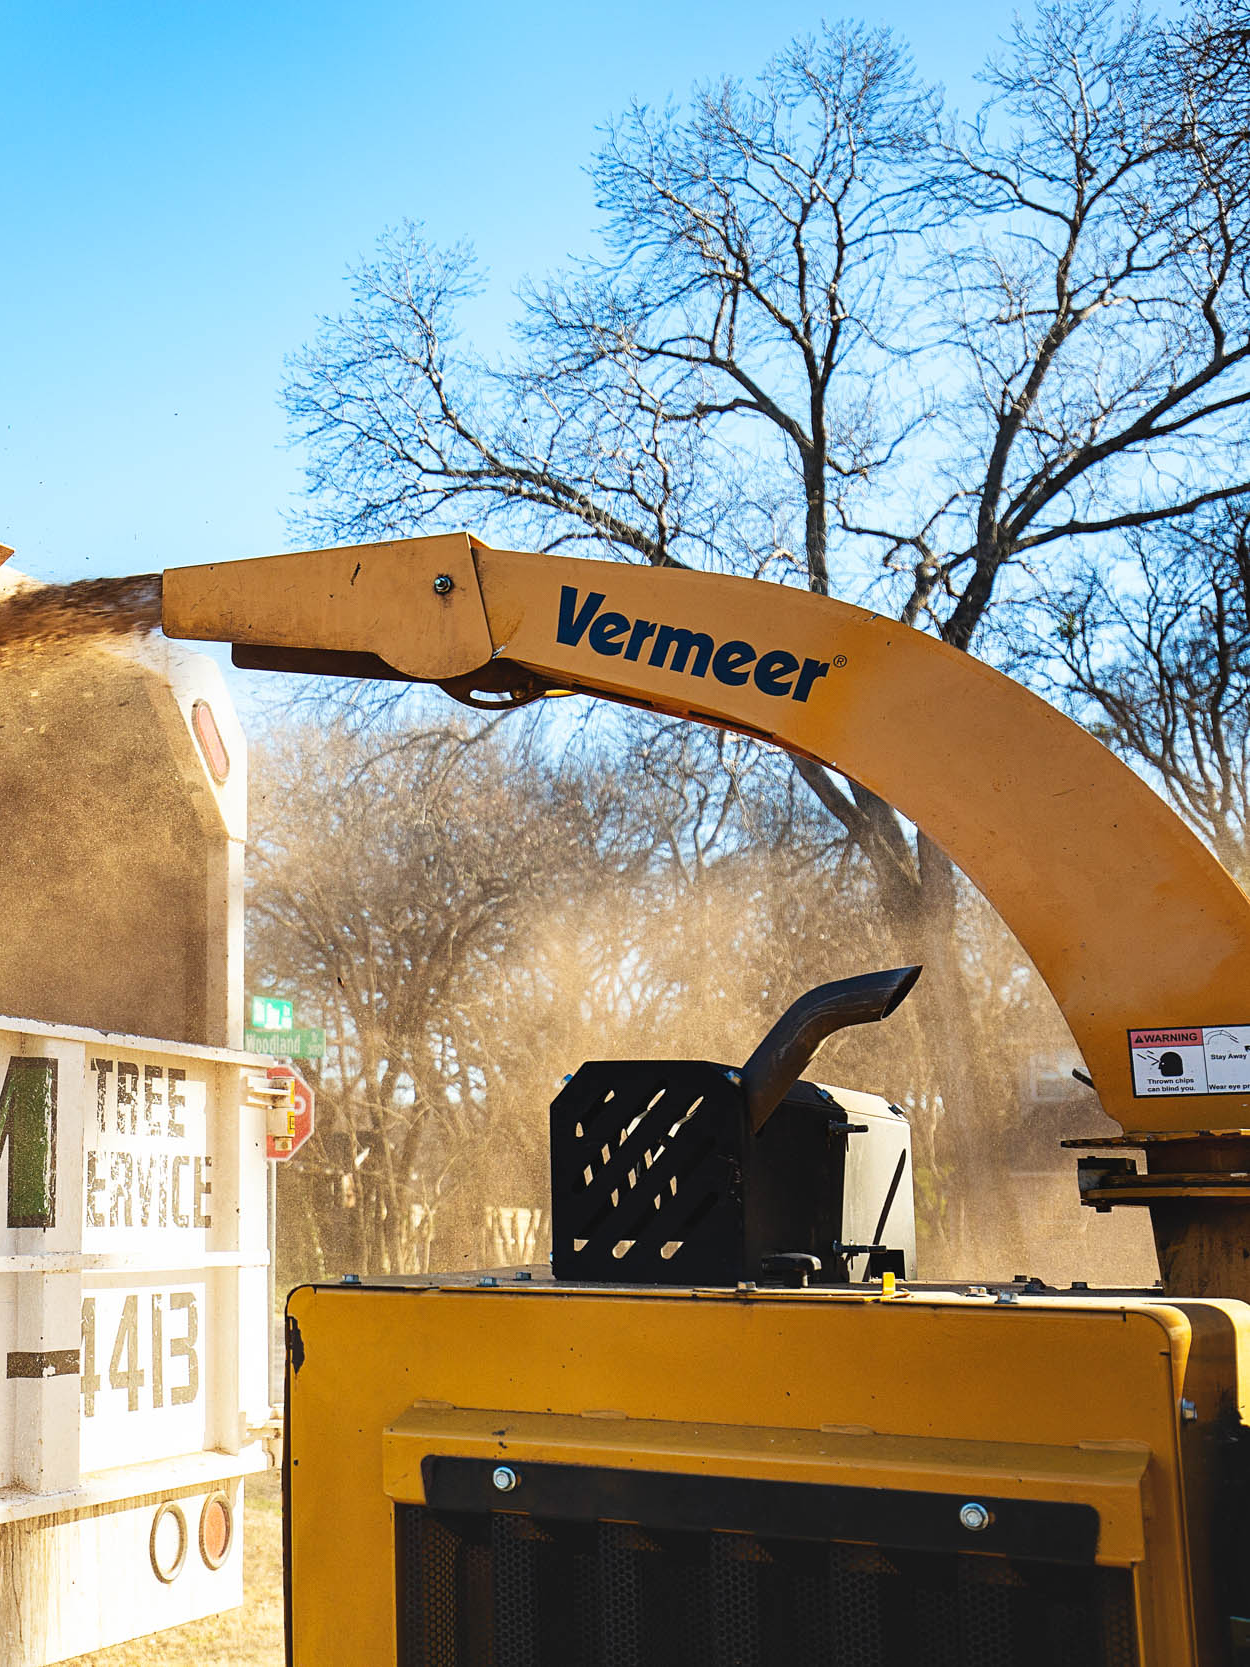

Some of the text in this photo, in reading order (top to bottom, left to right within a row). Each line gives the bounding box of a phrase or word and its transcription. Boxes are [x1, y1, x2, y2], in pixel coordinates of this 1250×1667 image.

[245, 1033, 301, 1055] Woodland
[1144, 1032, 1198, 1043] WARNING
[1210, 1053, 1227, 1061] Stay
[90, 1057, 186, 1138] TREE
[86, 1150, 212, 1229] ERVICE
